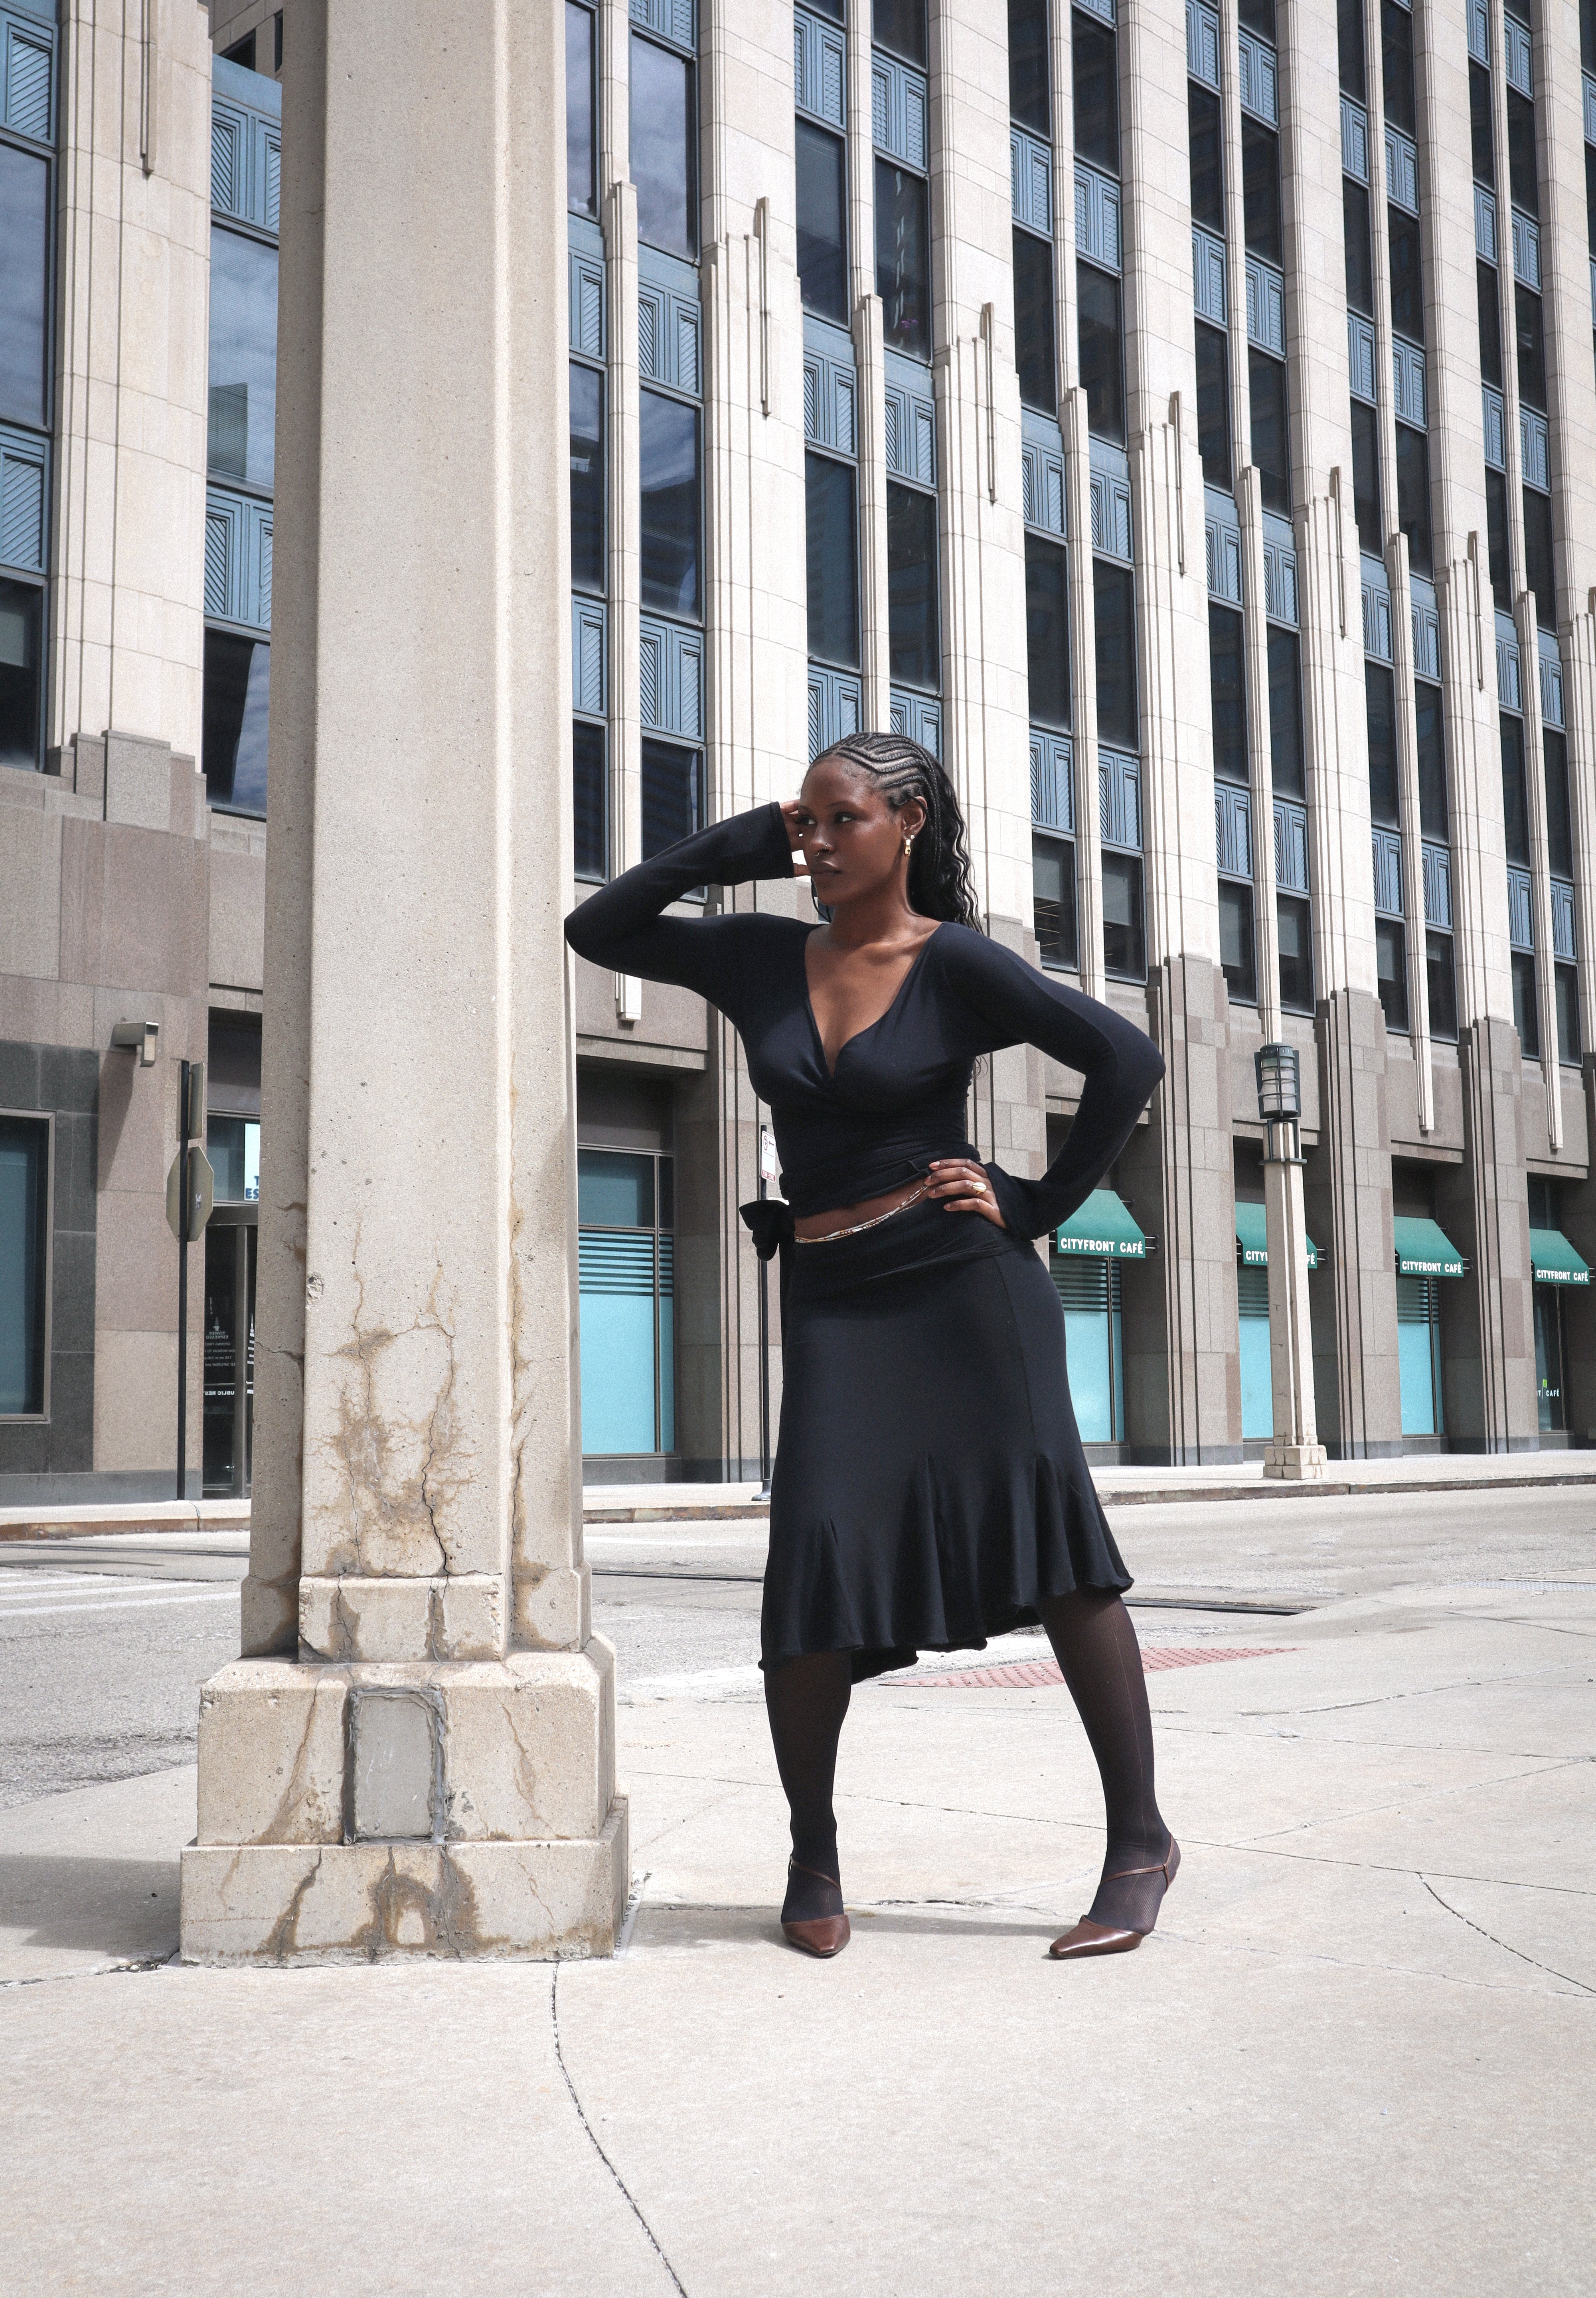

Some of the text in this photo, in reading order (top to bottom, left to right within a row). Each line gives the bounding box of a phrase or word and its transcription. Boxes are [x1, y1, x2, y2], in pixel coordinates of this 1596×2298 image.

[1061, 1238, 1143, 1254] CITYFRONT CAFÉ
[1402, 1260, 1462, 1273] CITYFRONT CAFÉ
[1537, 1269, 1588, 1282] CITYFRONT CAFÉ
[1546, 1388, 1560, 1397] CAFÉ
